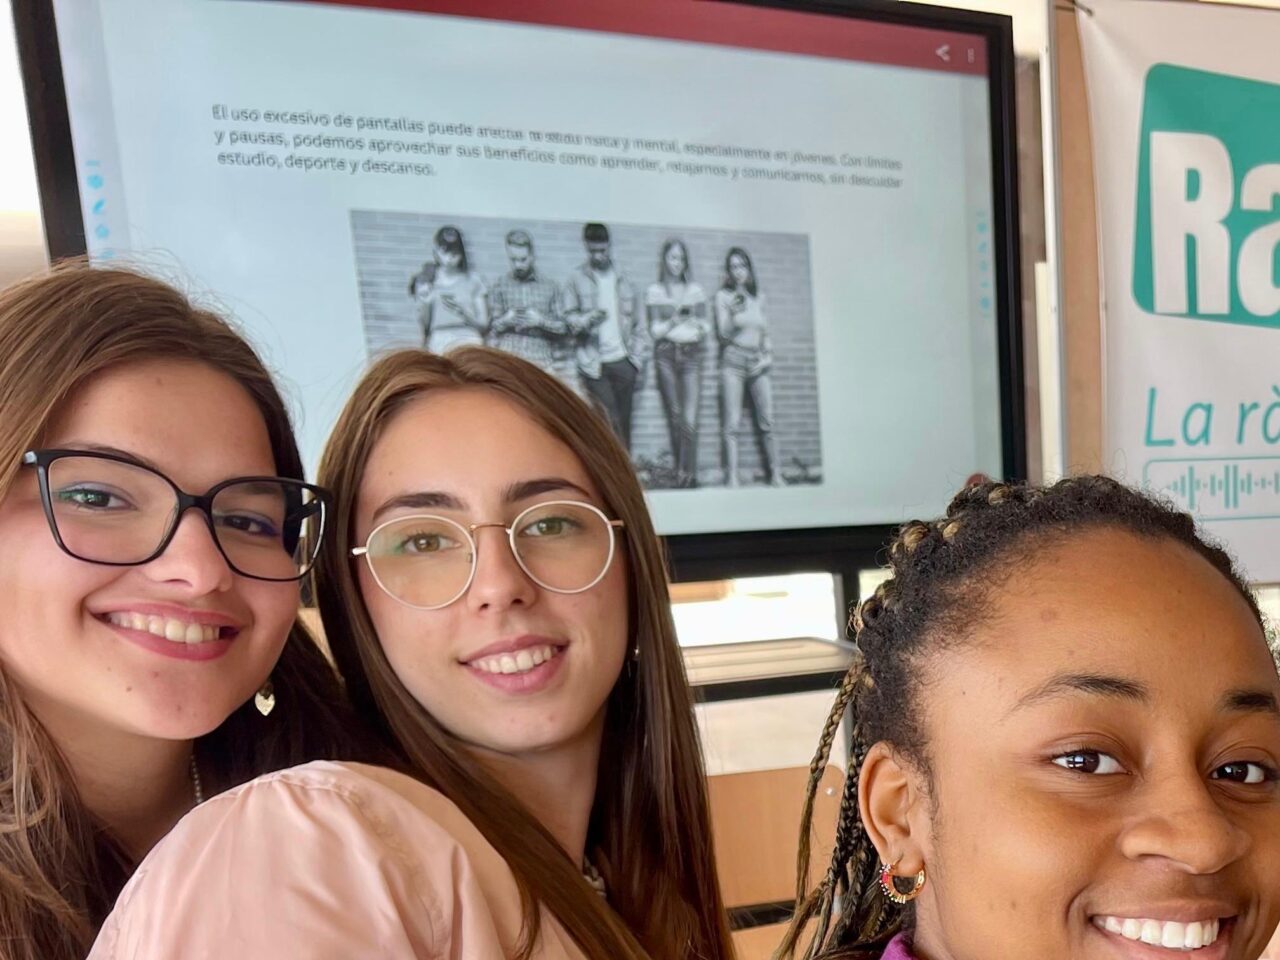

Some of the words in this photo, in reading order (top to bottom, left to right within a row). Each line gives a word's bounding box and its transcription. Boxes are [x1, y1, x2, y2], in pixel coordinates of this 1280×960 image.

[212, 104, 228, 120] El
[231, 108, 260, 122] uso
[263, 110, 331, 126] excesivo
[333, 113, 354, 127] de
[357, 115, 425, 133] pantallas
[428, 120, 473, 136] puede
[214, 130, 225, 146] y
[229, 130, 288, 148] pausas,
[293, 133, 366, 152] podemos
[368, 138, 452, 156] aprovechar
[456, 145, 481, 159] sus
[559, 152, 598, 167] como
[217, 151, 282, 170] estudio,
[285, 153, 346, 173] deporte
[1145, 388, 1212, 447] La
